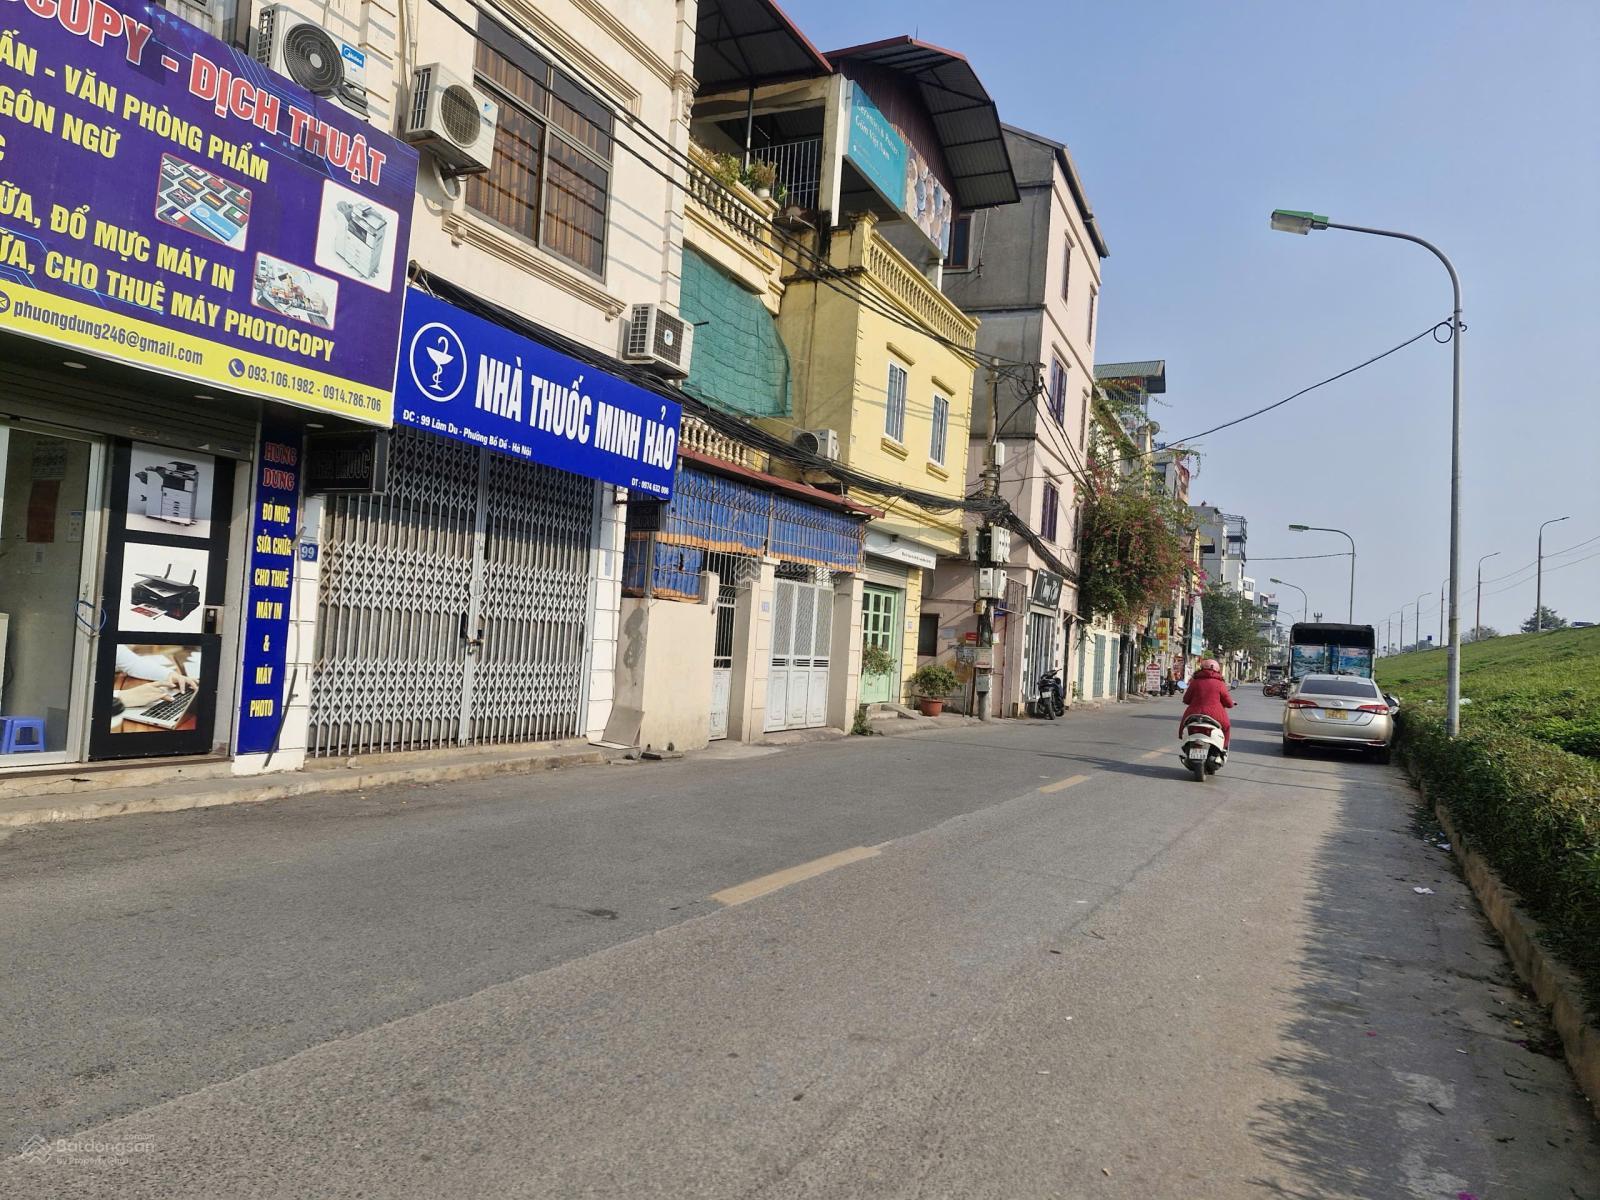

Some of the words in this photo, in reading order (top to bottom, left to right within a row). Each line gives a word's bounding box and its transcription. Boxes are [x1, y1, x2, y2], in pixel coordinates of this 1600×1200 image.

[62, 113, 121, 158] NGỮ
[65, 64, 117, 113] VĂN
[123, 93, 203, 153] PHÒNG
[207, 135, 269, 183] PHẨM
[189, 53, 280, 135] DỊCH
[289, 105, 386, 186] THUẬT
[50, 204, 90, 240] ĐỔ
[93, 220, 151, 262] MỰC
[157, 247, 206, 281] MÁY
[212, 262, 235, 292] IN
[45, 251, 98, 290] CHO
[106, 269, 166, 311] THUÊ
[171, 292, 219, 328] MÁY
[224, 315, 335, 362] PHOTOCOPY
[14, 299, 203, 365] phuongdung246@gmail.com
[247, 364, 314, 395] 093.106.1982
[323, 384, 381, 412] 0914.786.706
[420, 415, 431, 426] 99
[475, 354, 523, 422] NHÀ
[529, 374, 592, 444] THUỐC
[594, 401, 642, 460] MINH
[643, 405, 676, 470] HẢO
[301, 546, 315, 559] 99
[255, 568, 270, 586] CHO
[271, 568, 289, 588] THUÊ
[256, 598, 273, 619] MÁY
[273, 603, 283, 620] IN
[263, 634, 271, 652] &
[255, 664, 273, 685] MÁY
[249, 700, 273, 718] PHOTO
